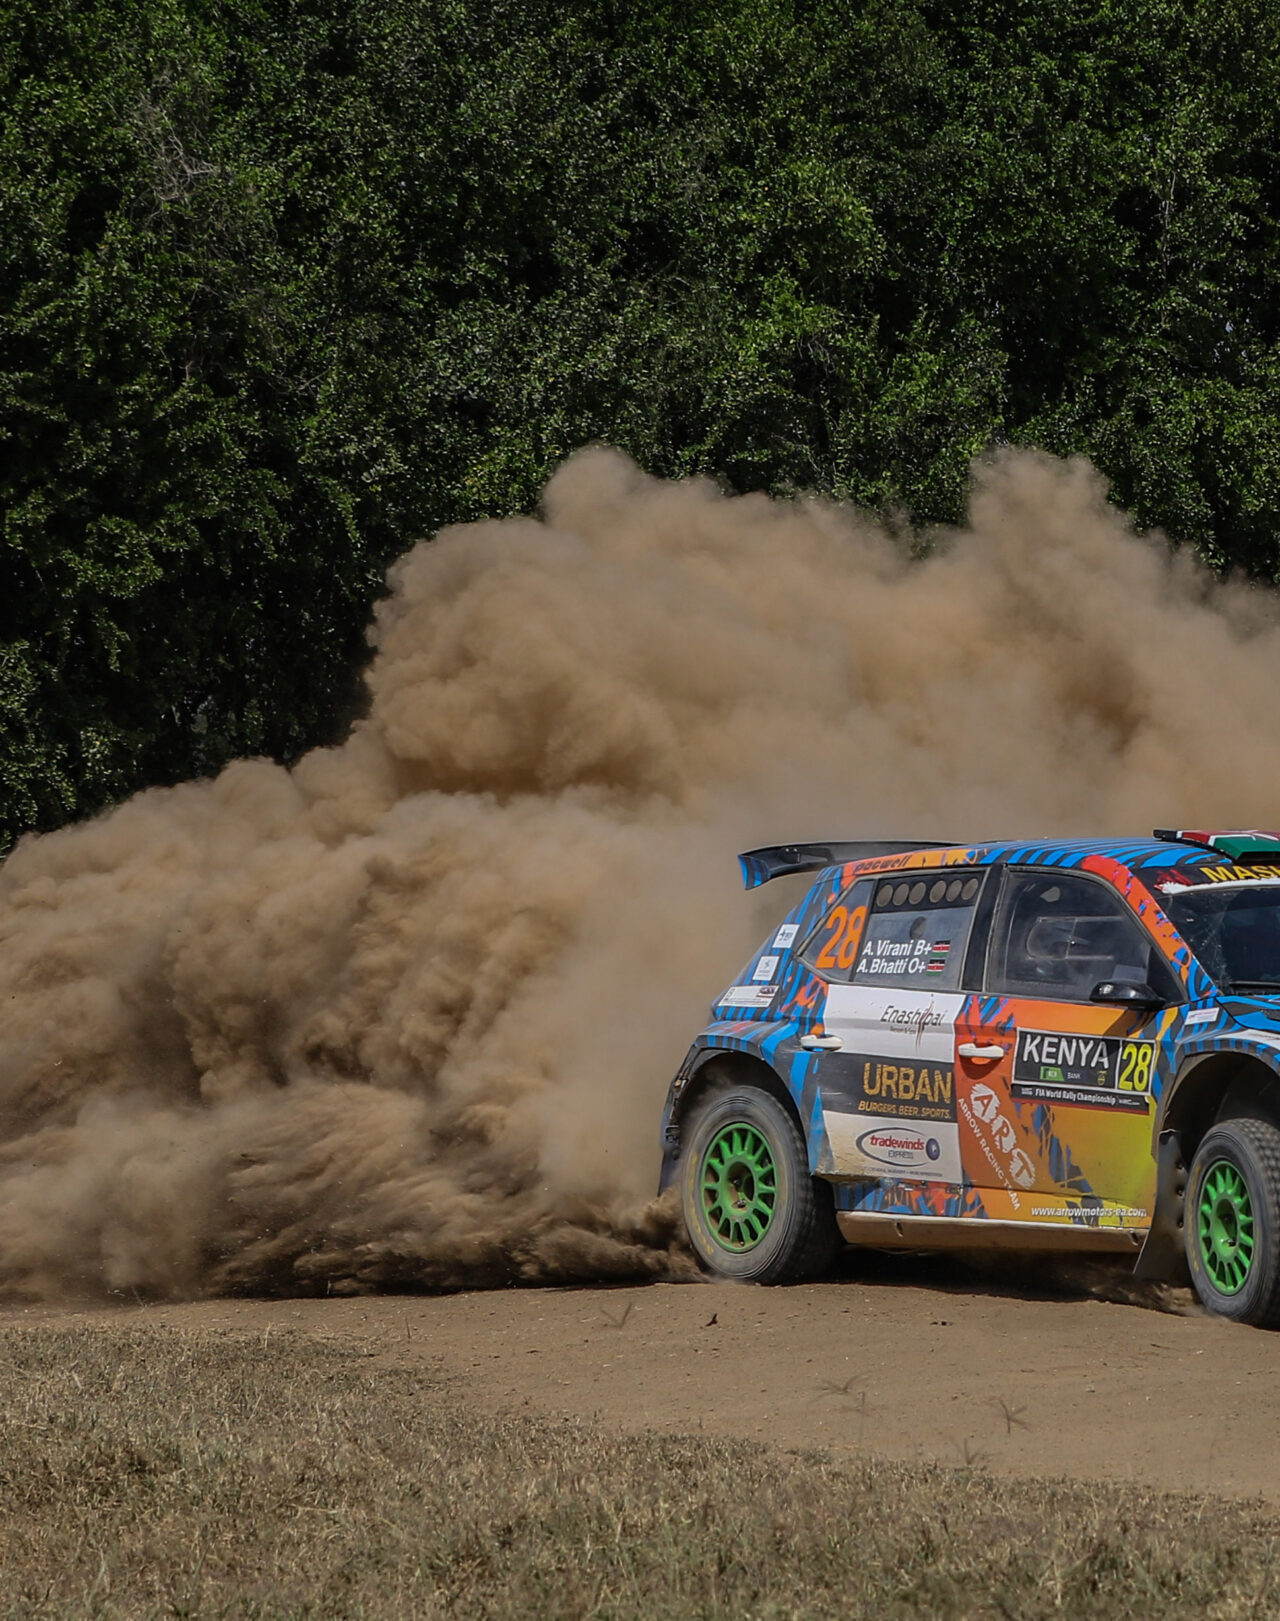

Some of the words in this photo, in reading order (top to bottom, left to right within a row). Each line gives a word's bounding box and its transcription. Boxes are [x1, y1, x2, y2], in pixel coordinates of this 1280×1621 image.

[815, 905, 868, 969] 28
[914, 940, 932, 956] B+
[908, 957, 926, 974] O+
[1023, 1034, 1109, 1069] KENYA
[1118, 1043, 1152, 1091] 28
[863, 1062, 953, 1104] URBAN
[1035, 1088, 1046, 1097] FIA
[1046, 1089, 1062, 1099] World
[1062, 1091, 1077, 1101] Rally
[1077, 1093, 1116, 1105] Championship
[870, 1135, 925, 1151] tradewinds
[958, 1098, 983, 1138] ARROW
[980, 1138, 1005, 1180] RACING
[1031, 1207, 1147, 1218] www.arrowmotors-ea.com
